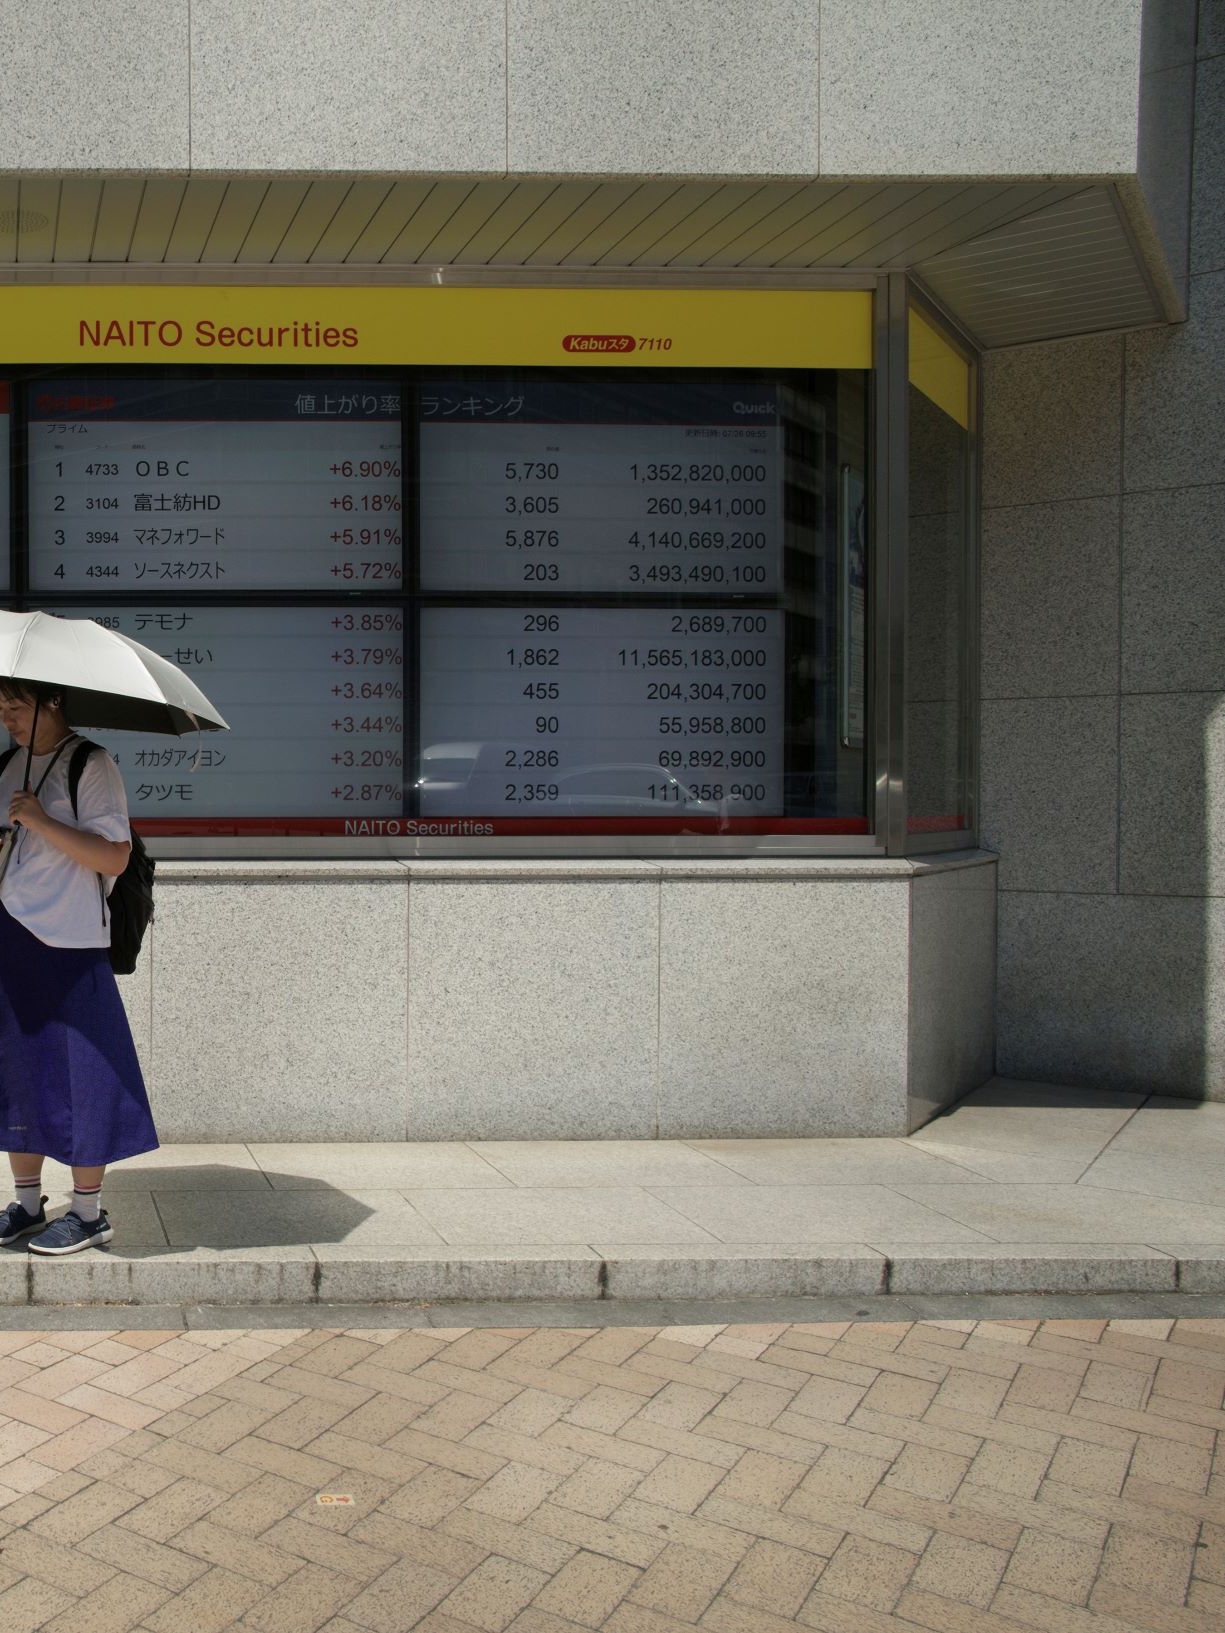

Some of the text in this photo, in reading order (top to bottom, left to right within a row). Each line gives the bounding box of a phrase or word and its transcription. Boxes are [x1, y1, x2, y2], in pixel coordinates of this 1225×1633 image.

[79, 320, 360, 347] NAITO Securities
[569, 337, 673, 352] Kabuスタ 7110
[55, 461, 63, 477] 1
[85, 463, 119, 476] 4733
[329, 460, 401, 478] +6.90%
[505, 462, 559, 482] 5,730
[630, 464, 766, 484] 1,352,820,000
[54, 492, 766, 518] 2 3104 富士紡HD +6.18% 3,605 260,941,000
[54, 527, 766, 551] 3 3994 マネフォワード +5.91% 5,876 4,140,669,200
[53, 560, 766, 585] 4 4344 ソースネクスト +5.72% 203 3,493,490,100
[135, 613, 194, 631] テモナ
[331, 614, 402, 632] +3.85%
[523, 615, 560, 633] 296
[670, 616, 767, 636] 2,689,700
[331, 648, 402, 666] +3.79%
[506, 648, 560, 669] 1,862
[618, 650, 766, 670] 11,565,183,000
[331, 682, 766, 703] +3.64% 455 204,304,700
[331, 716, 766, 737] +3.44% 90 55,958,800
[134, 747, 226, 767] オカダアイヨン
[331, 750, 402, 768] +3.20%
[504, 750, 560, 770] 2,286
[658, 751, 766, 771] 69,892,900
[135, 783, 766, 804] タツモ +2.87% 2,359 111,358,900
[344, 820, 494, 836] NAITO Securities
